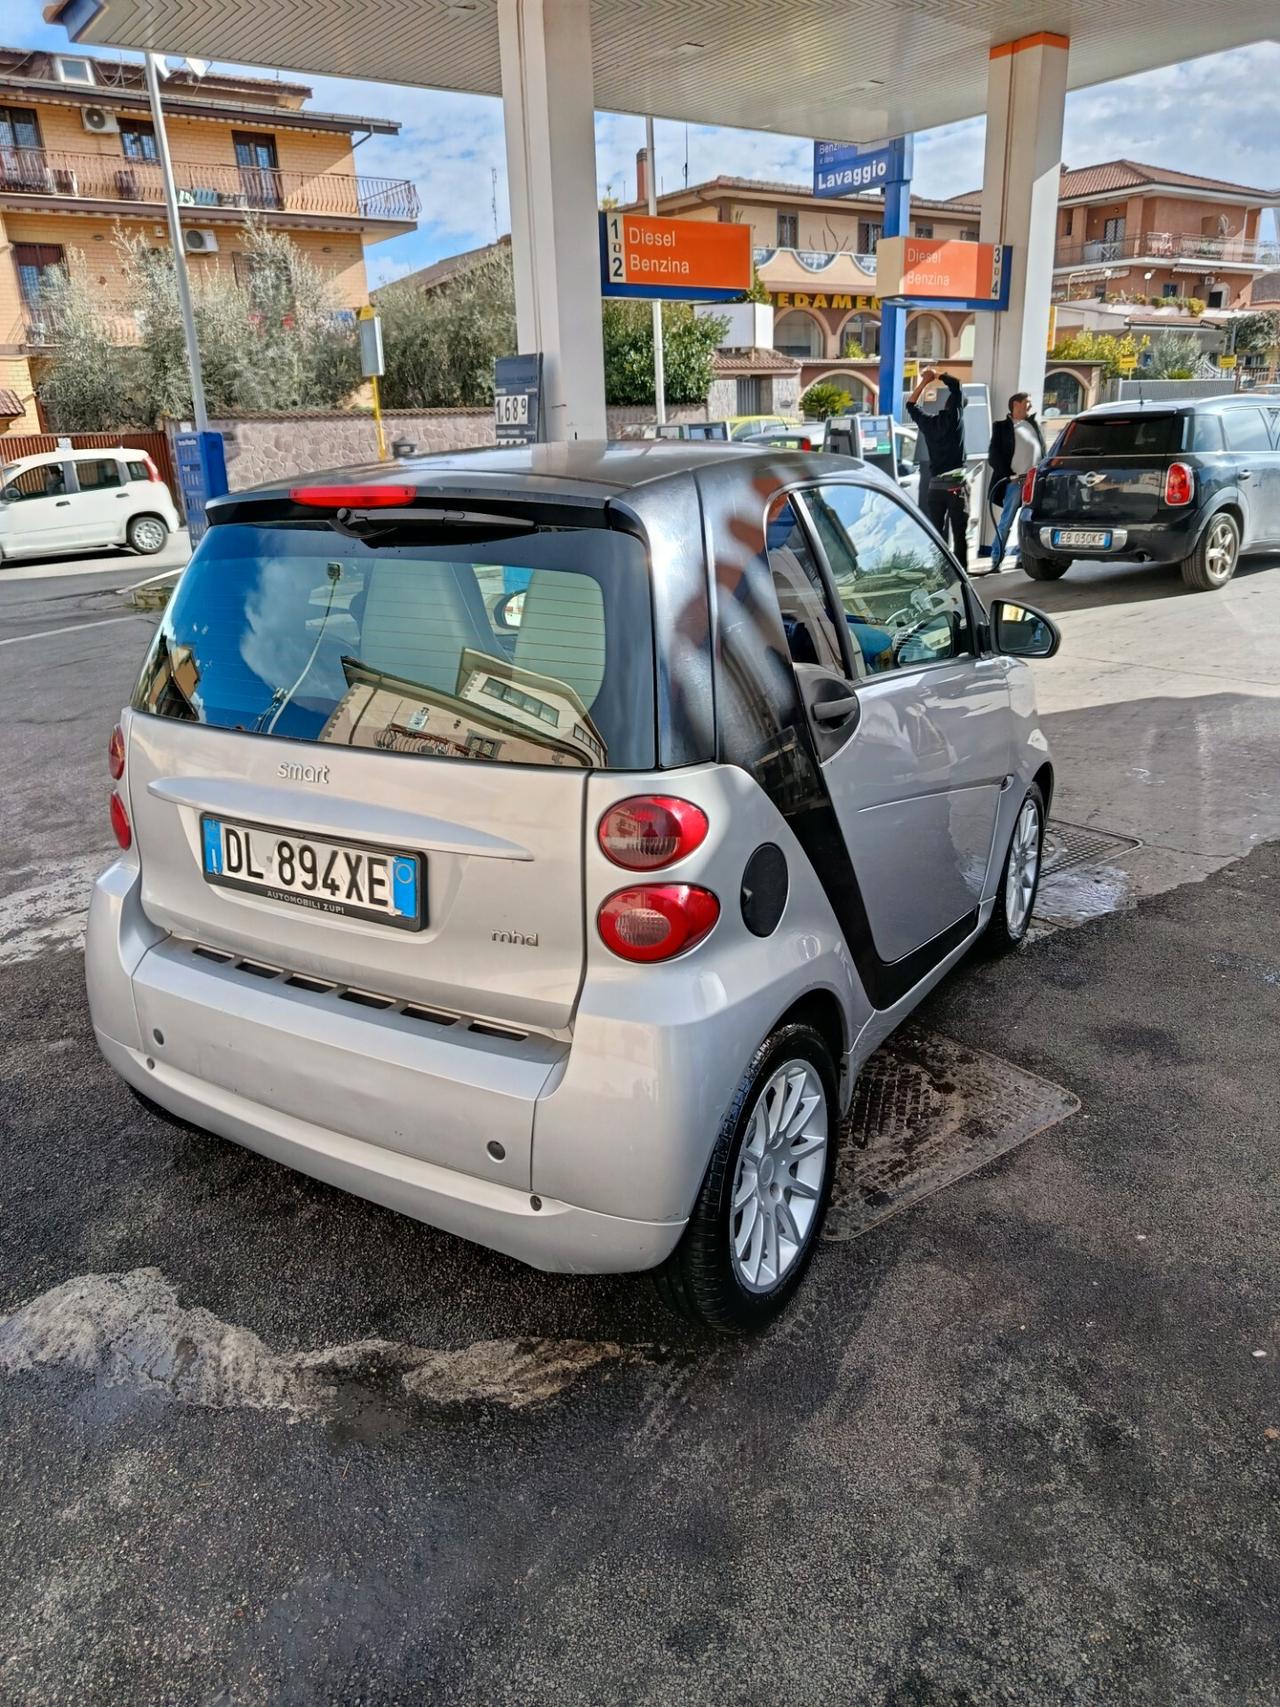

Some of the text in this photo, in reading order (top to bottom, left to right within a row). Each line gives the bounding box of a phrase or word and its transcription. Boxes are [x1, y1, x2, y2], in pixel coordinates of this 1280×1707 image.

[819, 143, 849, 155] Benzi
[818, 160, 887, 190] Lavaggio
[610, 219, 619, 240] 1
[628, 227, 676, 247] Diesel
[630, 254, 690, 274] Benzina
[907, 248, 942, 265] Diesel
[994, 247, 1001, 264] 3
[612, 257, 624, 277] 2
[906, 271, 950, 287] Benzina
[991, 280, 999, 296] 4
[276, 761, 330, 784] smart
[224, 827, 389, 907] DL 894XE
[266, 890, 345, 914] AUTOMOBILI ZUPI
[491, 929, 539, 947] mhd
